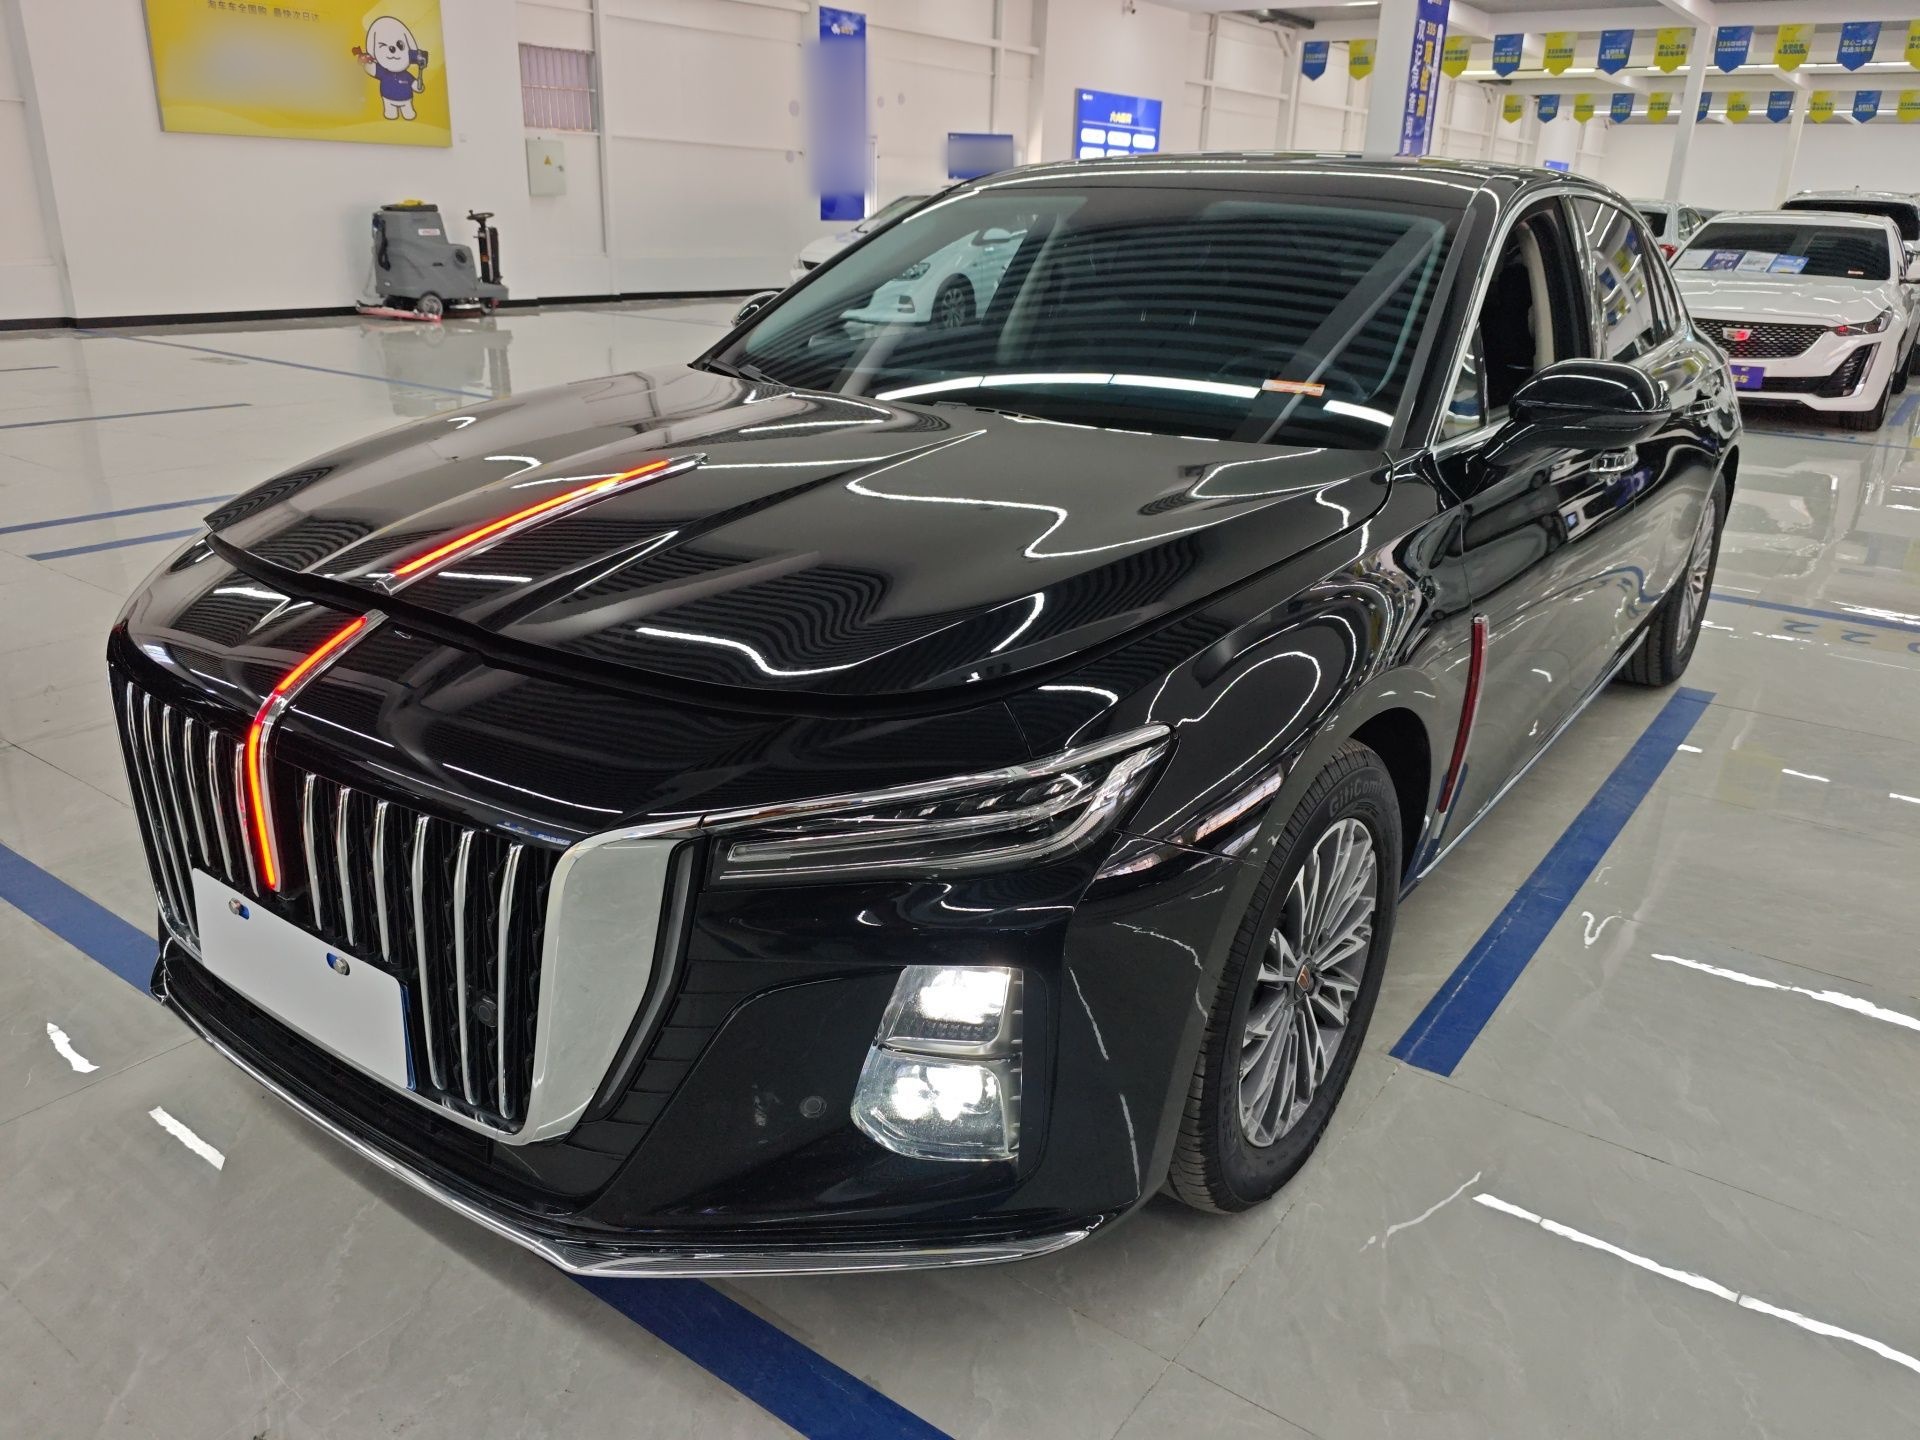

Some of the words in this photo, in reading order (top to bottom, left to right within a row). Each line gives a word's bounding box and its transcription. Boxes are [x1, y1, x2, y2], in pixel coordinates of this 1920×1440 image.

[207, 0, 267, 16] 淘车车全国购
[273, 7, 320, 22] 最快次日达
